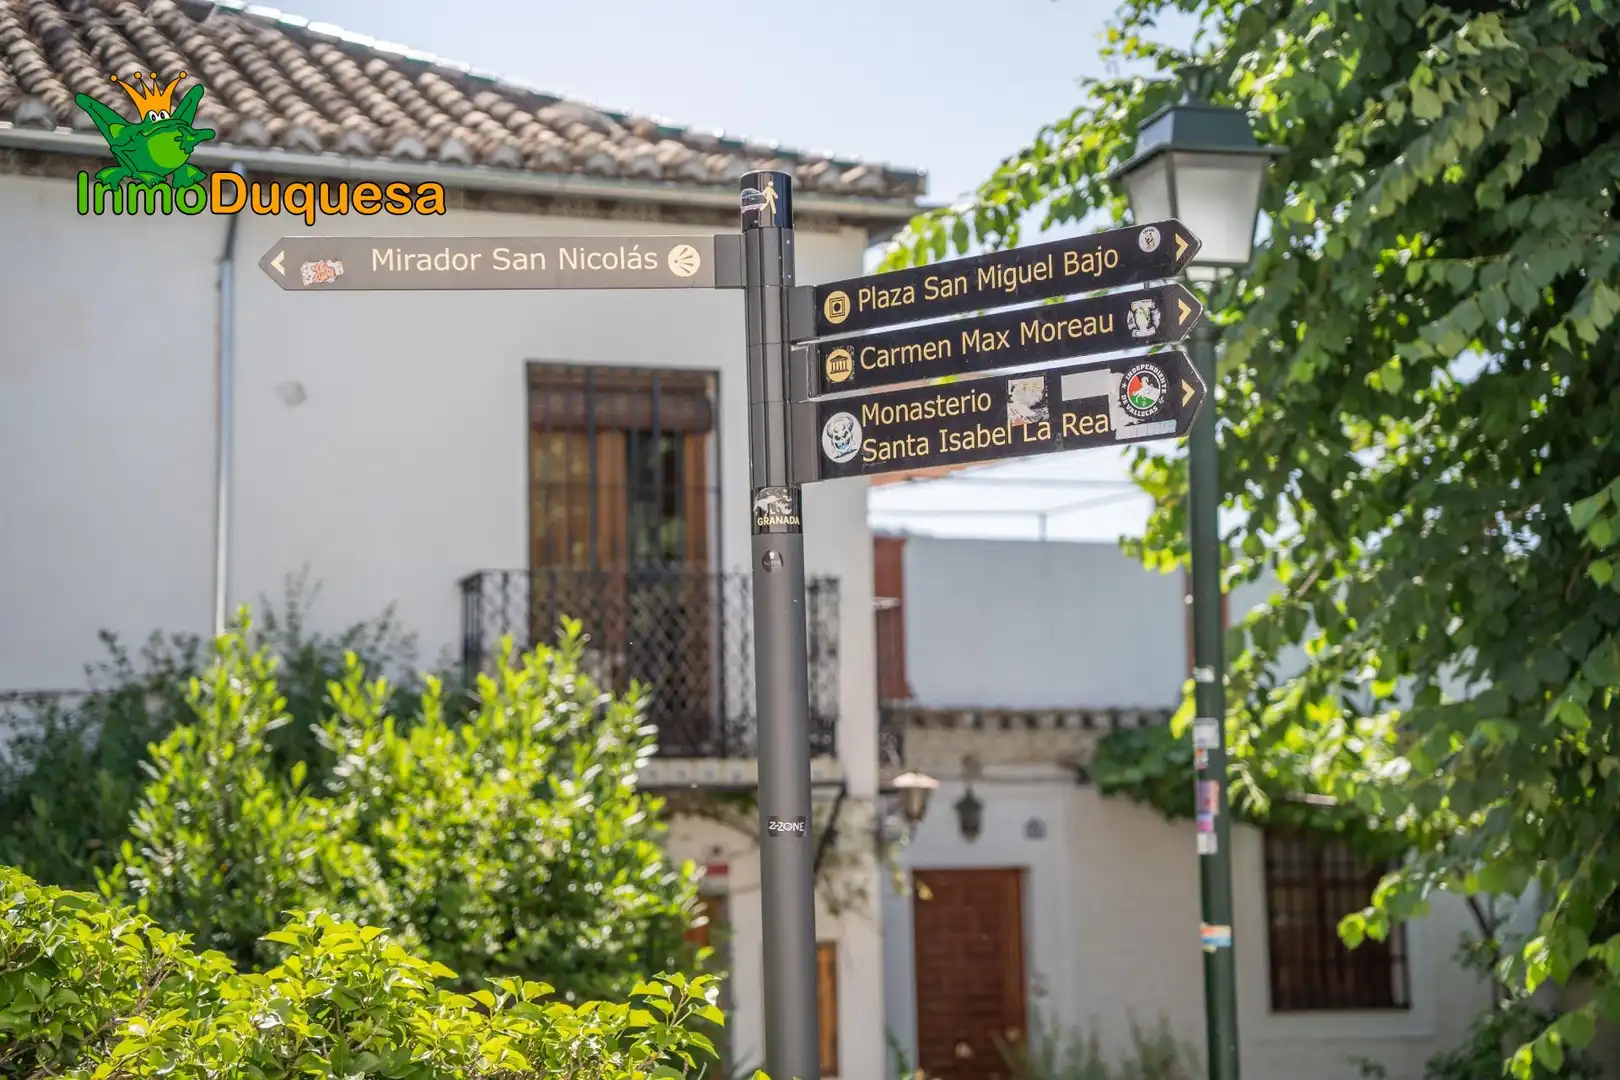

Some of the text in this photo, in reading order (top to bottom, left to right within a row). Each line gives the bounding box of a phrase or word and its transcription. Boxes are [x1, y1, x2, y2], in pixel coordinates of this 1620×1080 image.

[371, 244, 659, 272] Mirador San Nicolás
[857, 245, 1120, 312] Plaza San Miguel Bajo
[859, 312, 1114, 370] Carmen Max Moreau
[1125, 364, 1167, 394] INDEPENDIENTE
[861, 389, 992, 428] Monasterio
[1126, 404, 1158, 417] VALLECAS
[862, 411, 1112, 463] Santa Isabel La Rea
[757, 515, 800, 526] GRANADA
[768, 821, 805, 832] Z-ZONE
